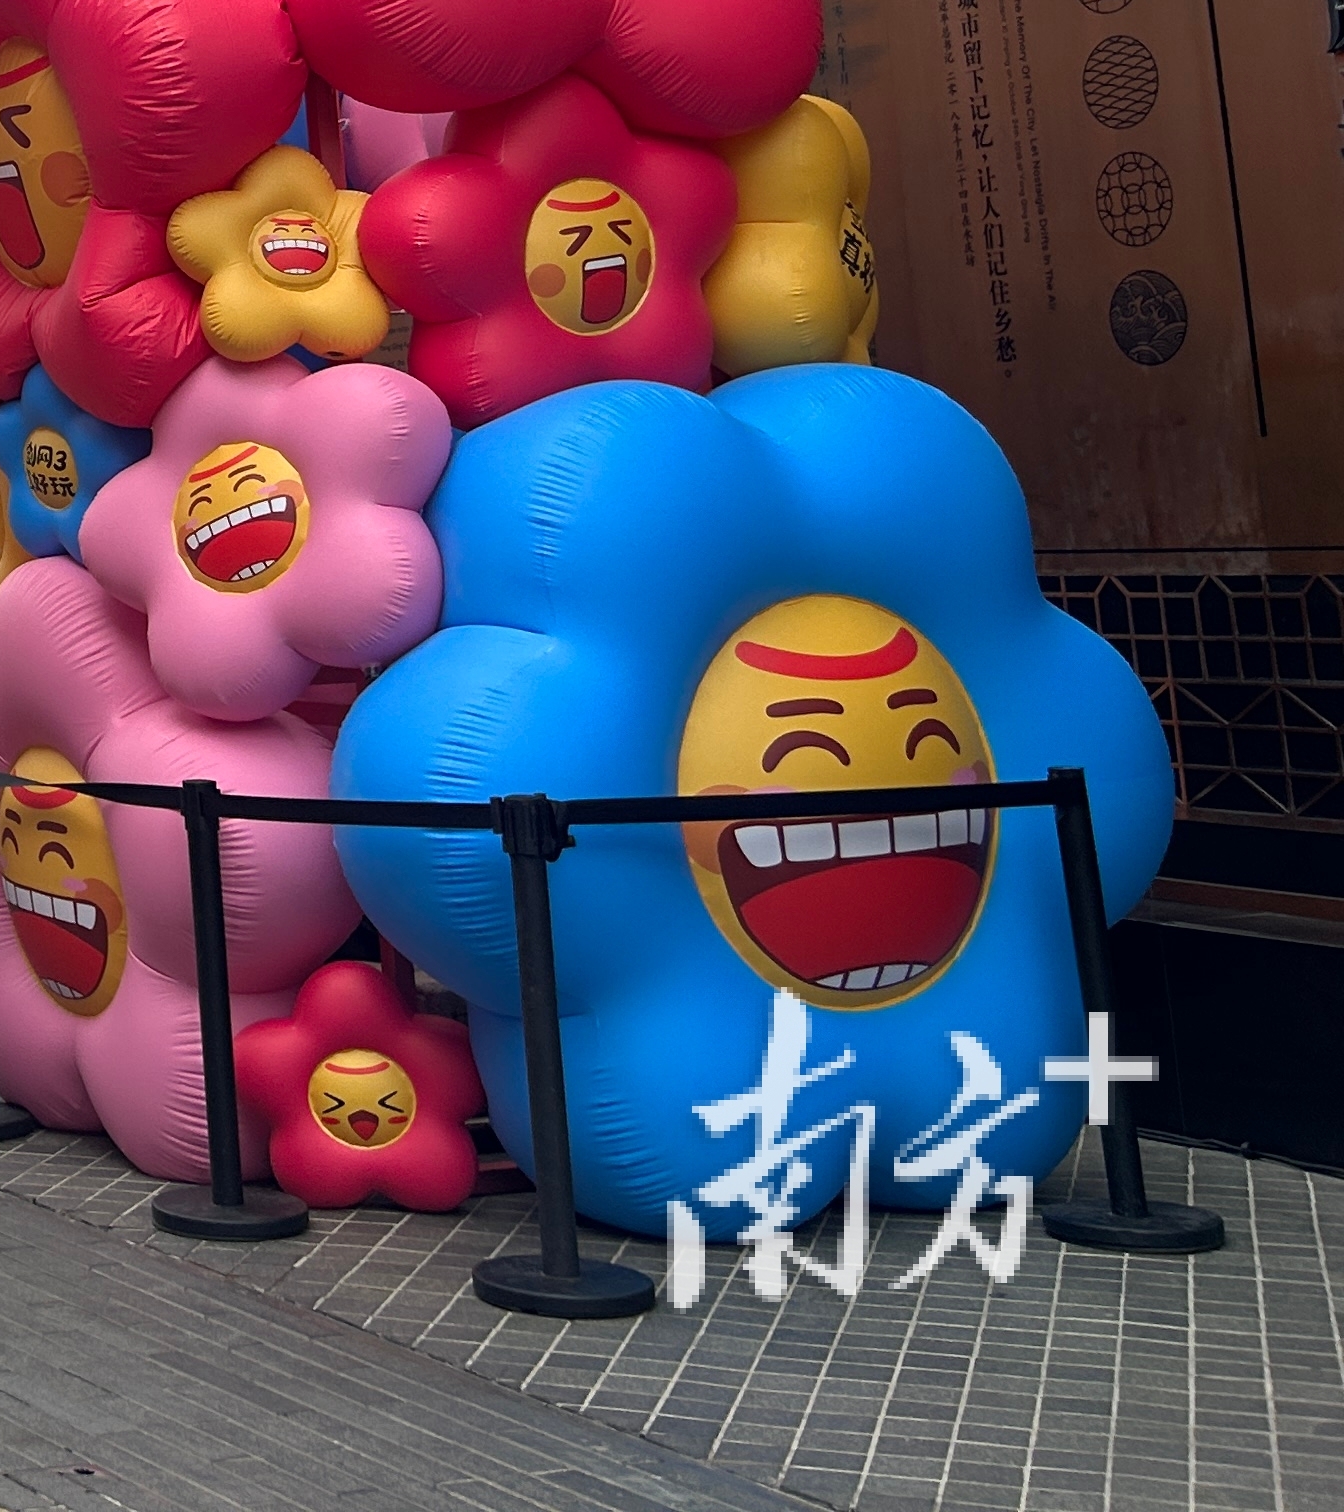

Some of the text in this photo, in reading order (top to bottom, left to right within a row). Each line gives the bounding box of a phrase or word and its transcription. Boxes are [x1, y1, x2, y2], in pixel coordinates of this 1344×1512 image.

[1016, 15, 1026, 62] Memory
[1022, 65, 1031, 80] Of
[1024, 83, 1032, 105] The
[1030, 137, 1039, 157] Let
[1033, 160, 1045, 215] Nostalgia
[1038, 218, 1050, 252] Drifts
[1045, 269, 1054, 291] The
